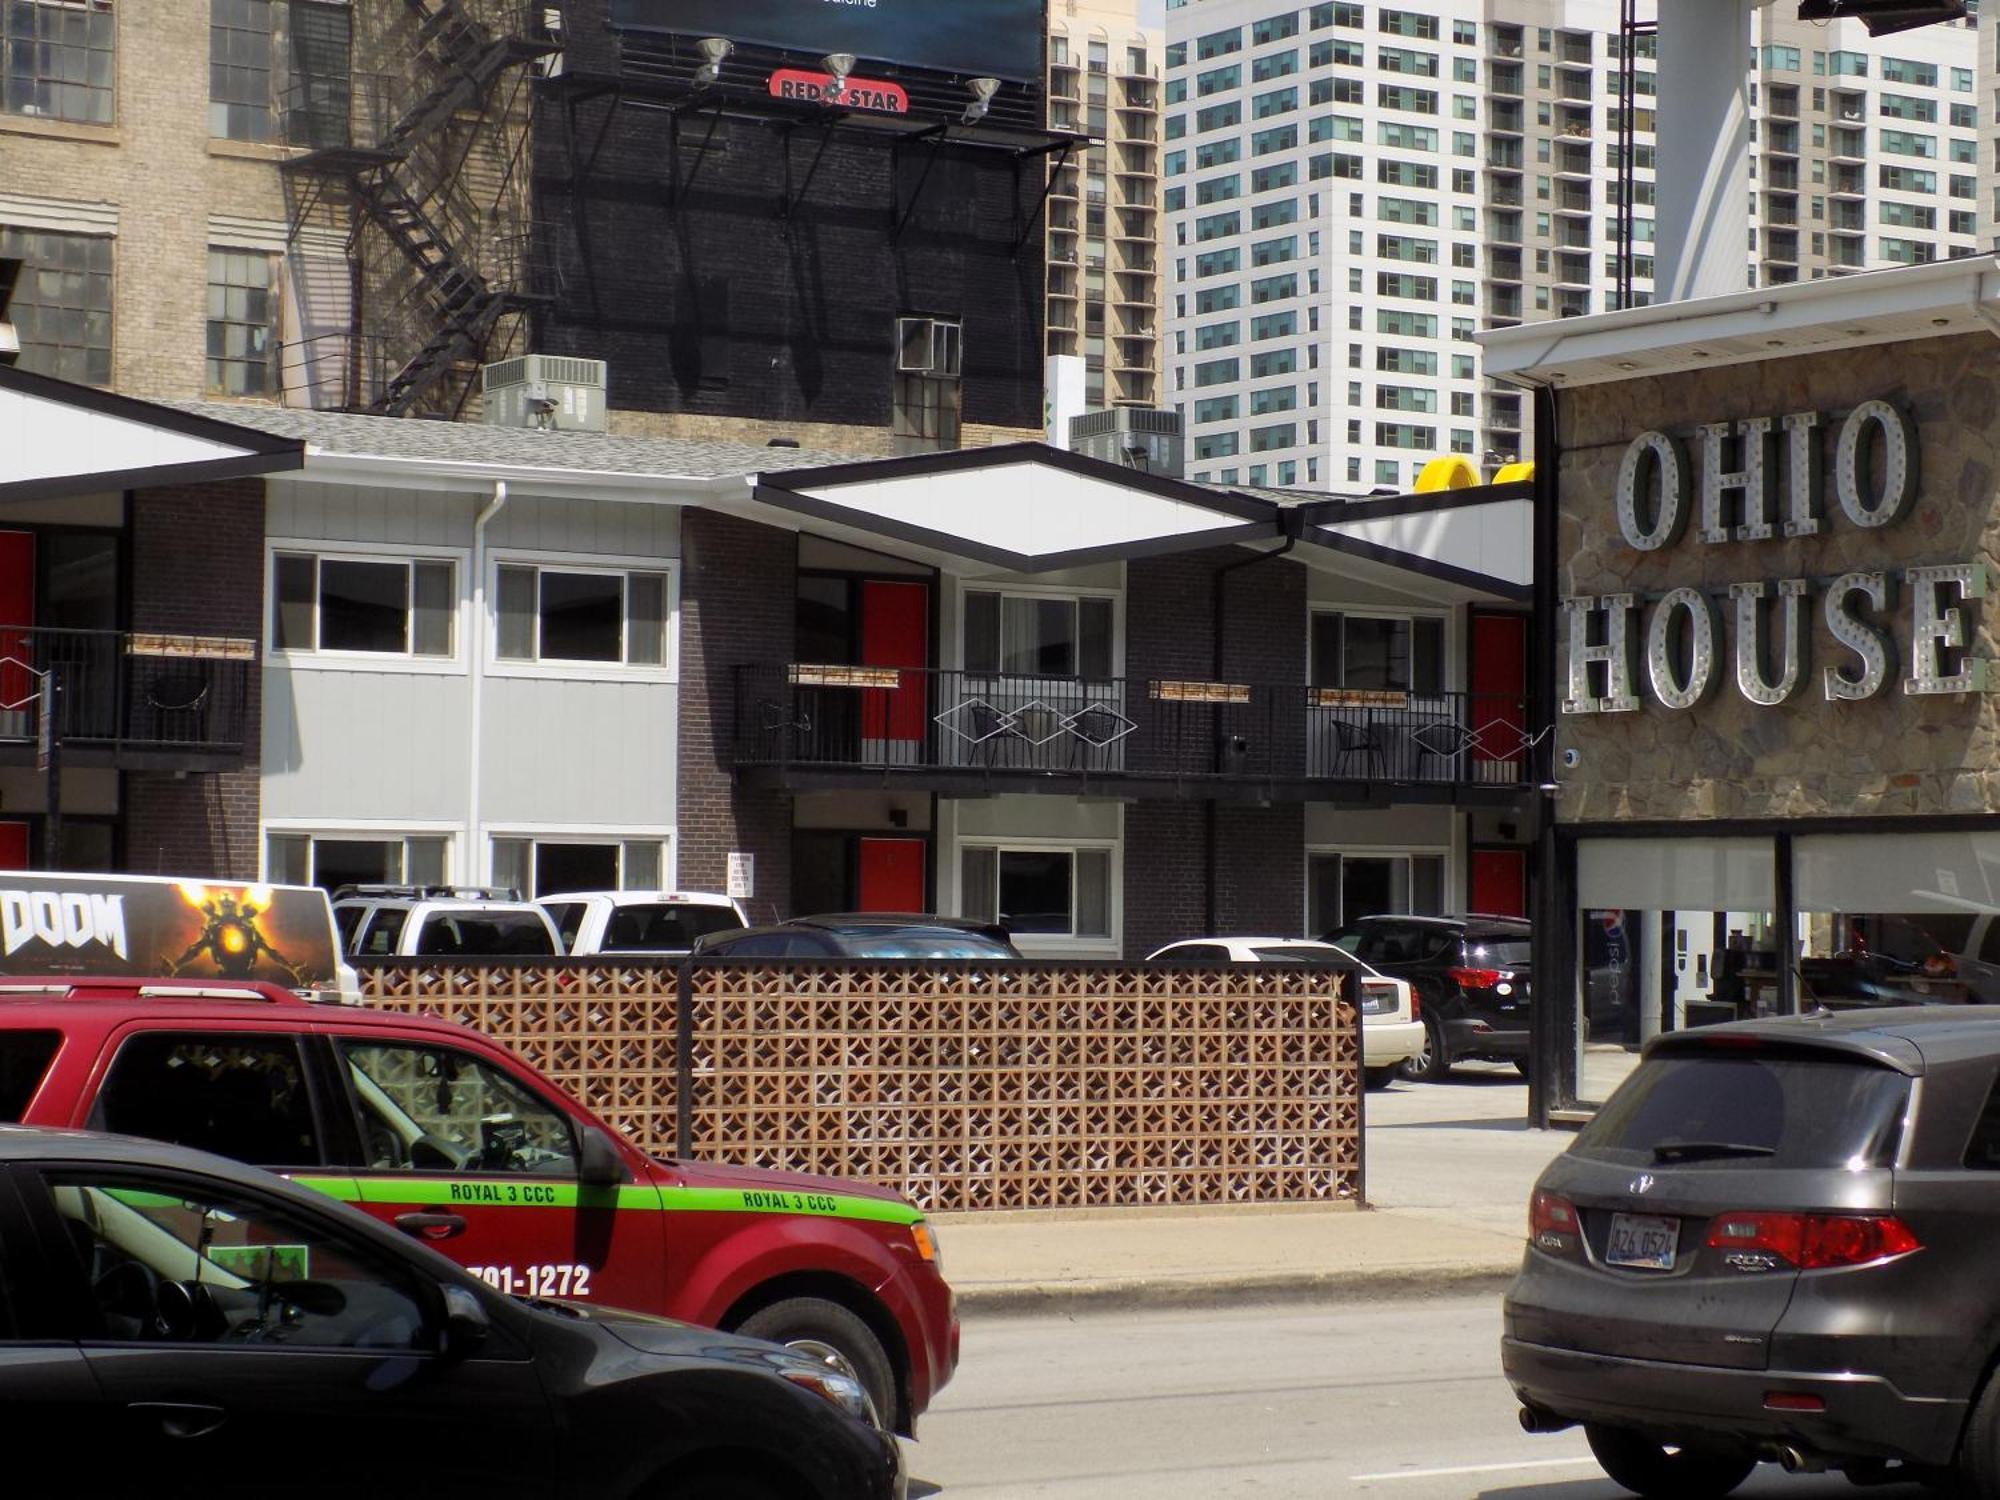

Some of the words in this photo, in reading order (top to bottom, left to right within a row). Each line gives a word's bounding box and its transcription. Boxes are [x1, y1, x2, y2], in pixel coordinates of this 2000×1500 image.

[781, 81, 820, 100] RED
[849, 89, 899, 111] STAR
[1617, 400, 1914, 551] OHIO
[1562, 563, 1985, 714] HOUSE
[0, 890, 127, 960] DOOM
[451, 1184, 502, 1201] ROYAL
[507, 1186, 516, 1201] 3
[524, 1187, 555, 1203] CCC
[743, 1192, 789, 1209] ROYAL
[794, 1195, 803, 1209] 3
[808, 1196, 836, 1211] CCC
[1725, 1253, 1776, 1267] RDX
